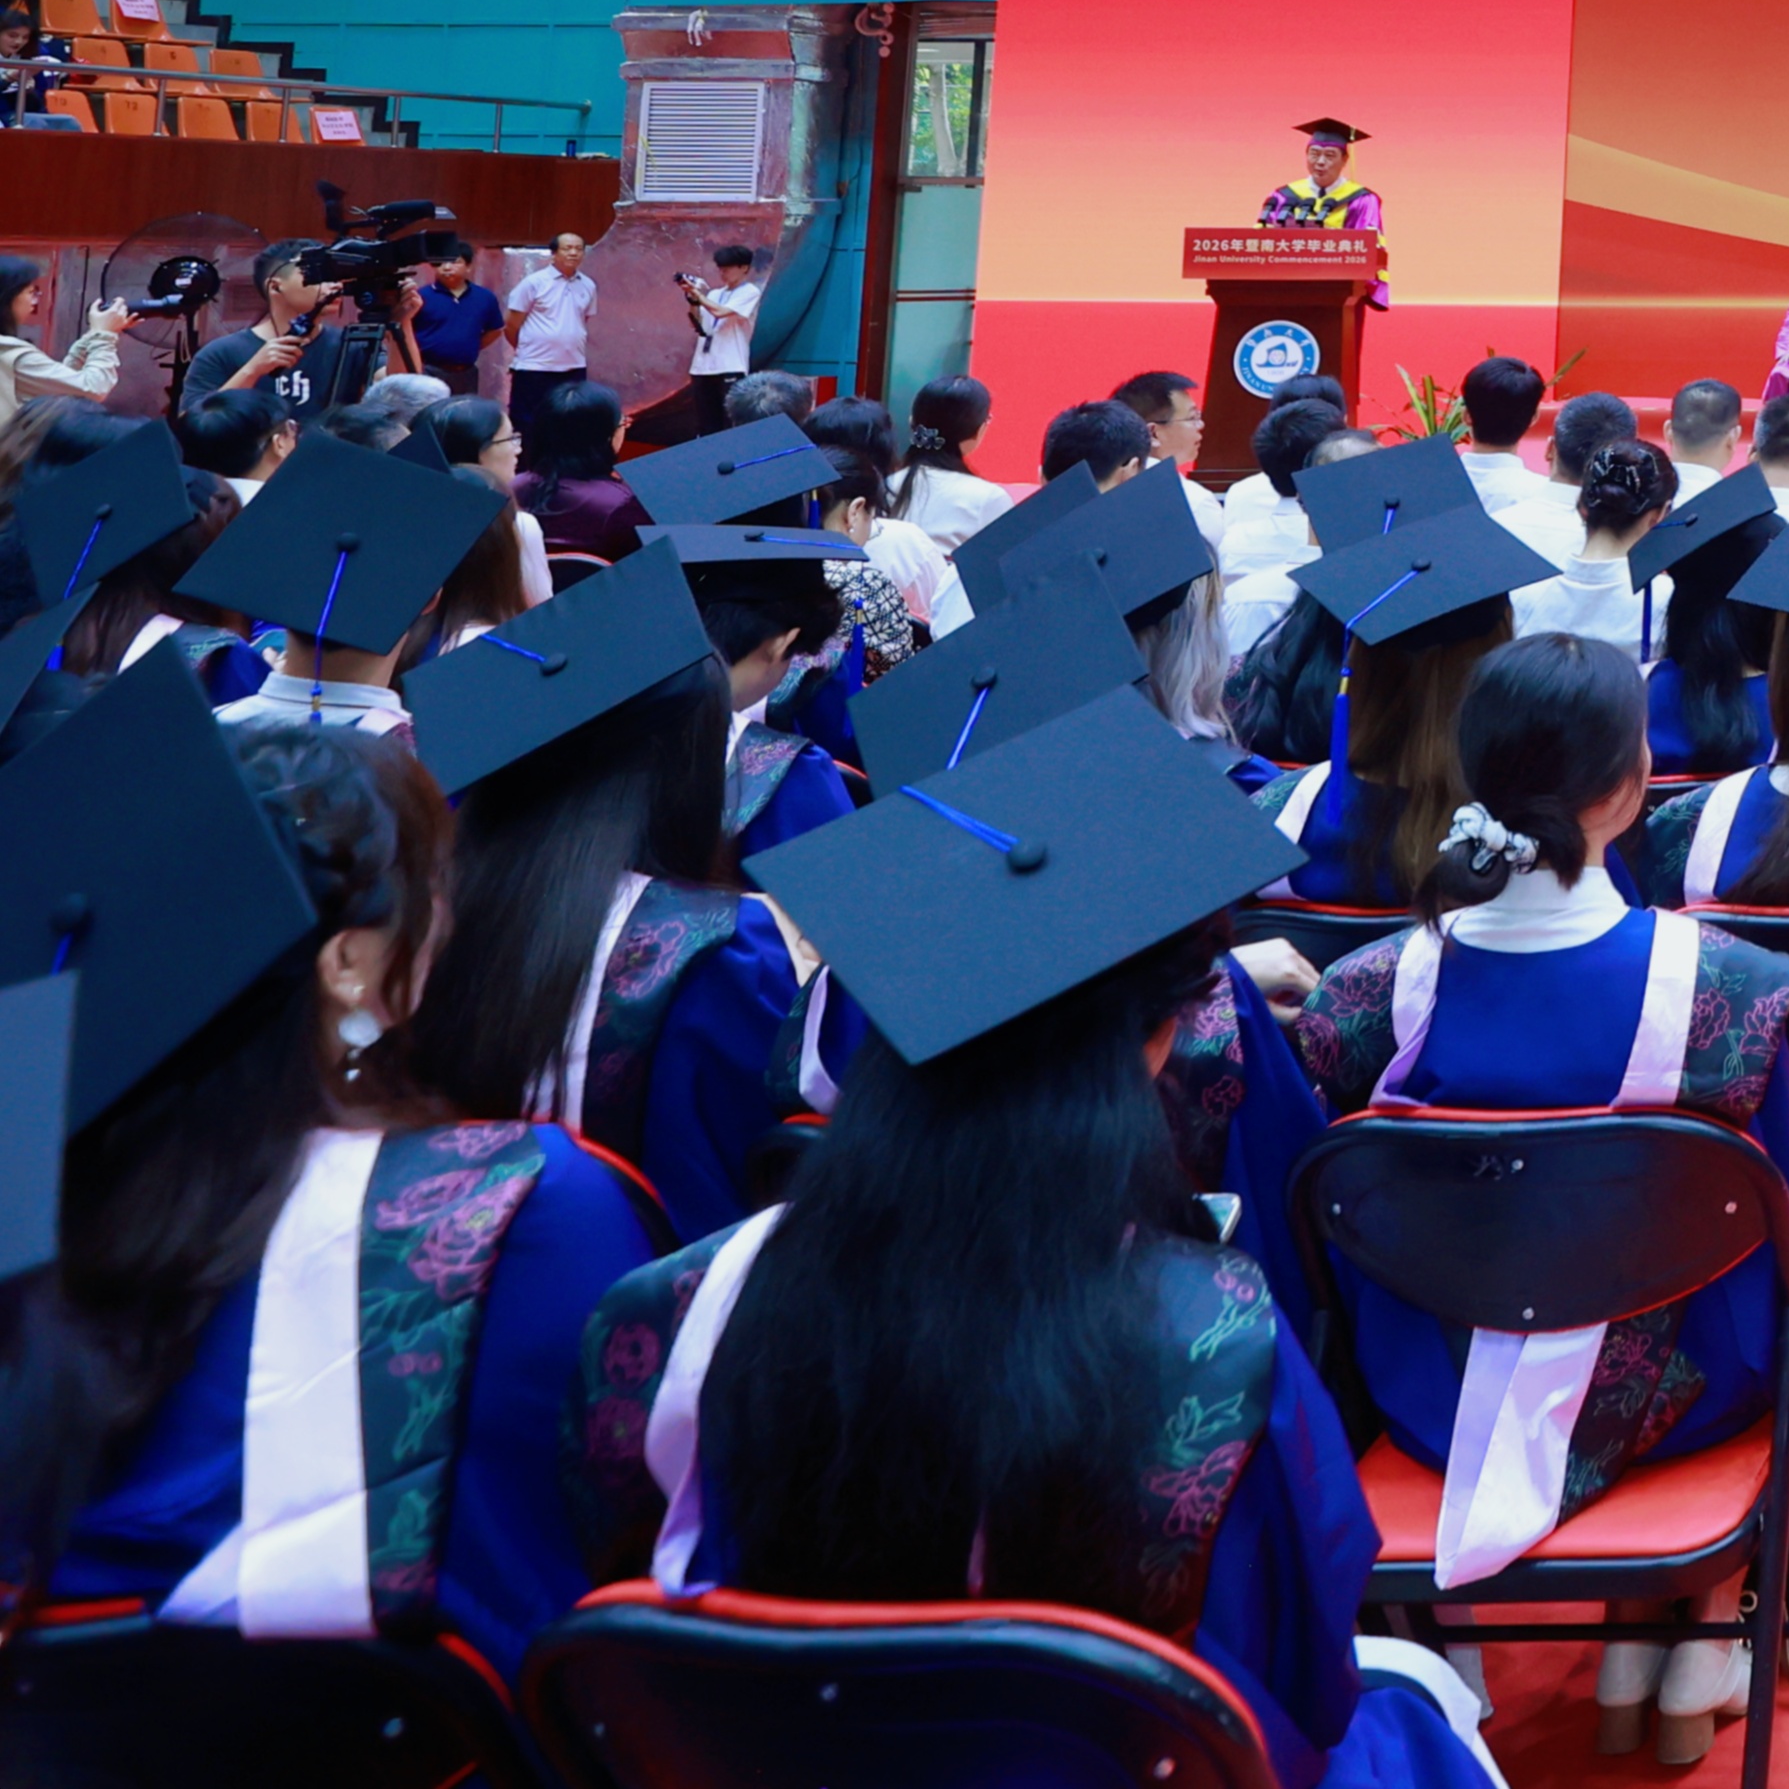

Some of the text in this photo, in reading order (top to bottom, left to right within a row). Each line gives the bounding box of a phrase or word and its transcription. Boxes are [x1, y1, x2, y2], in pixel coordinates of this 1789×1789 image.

[1192, 238, 1368, 253] 2026年暨南大学毕业典礼
[1193, 255, 1368, 265] Jinan University Commencement 2026
